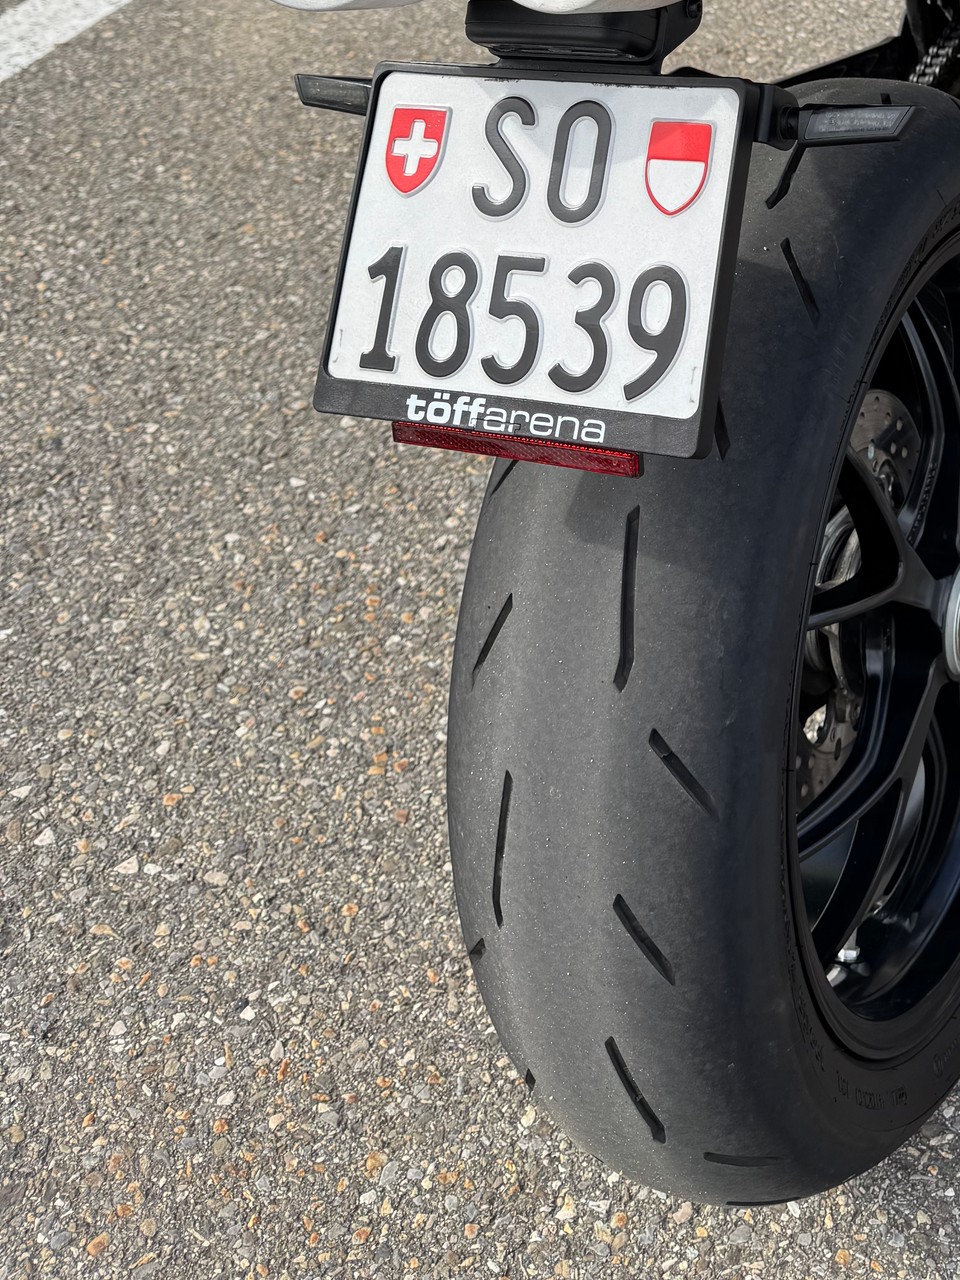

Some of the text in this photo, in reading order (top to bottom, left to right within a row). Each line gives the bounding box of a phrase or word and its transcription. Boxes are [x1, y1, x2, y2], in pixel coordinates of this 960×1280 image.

[472, 96, 613, 223] SO
[359, 246, 687, 400] 18539
[406, 392, 606, 443] töffarena
